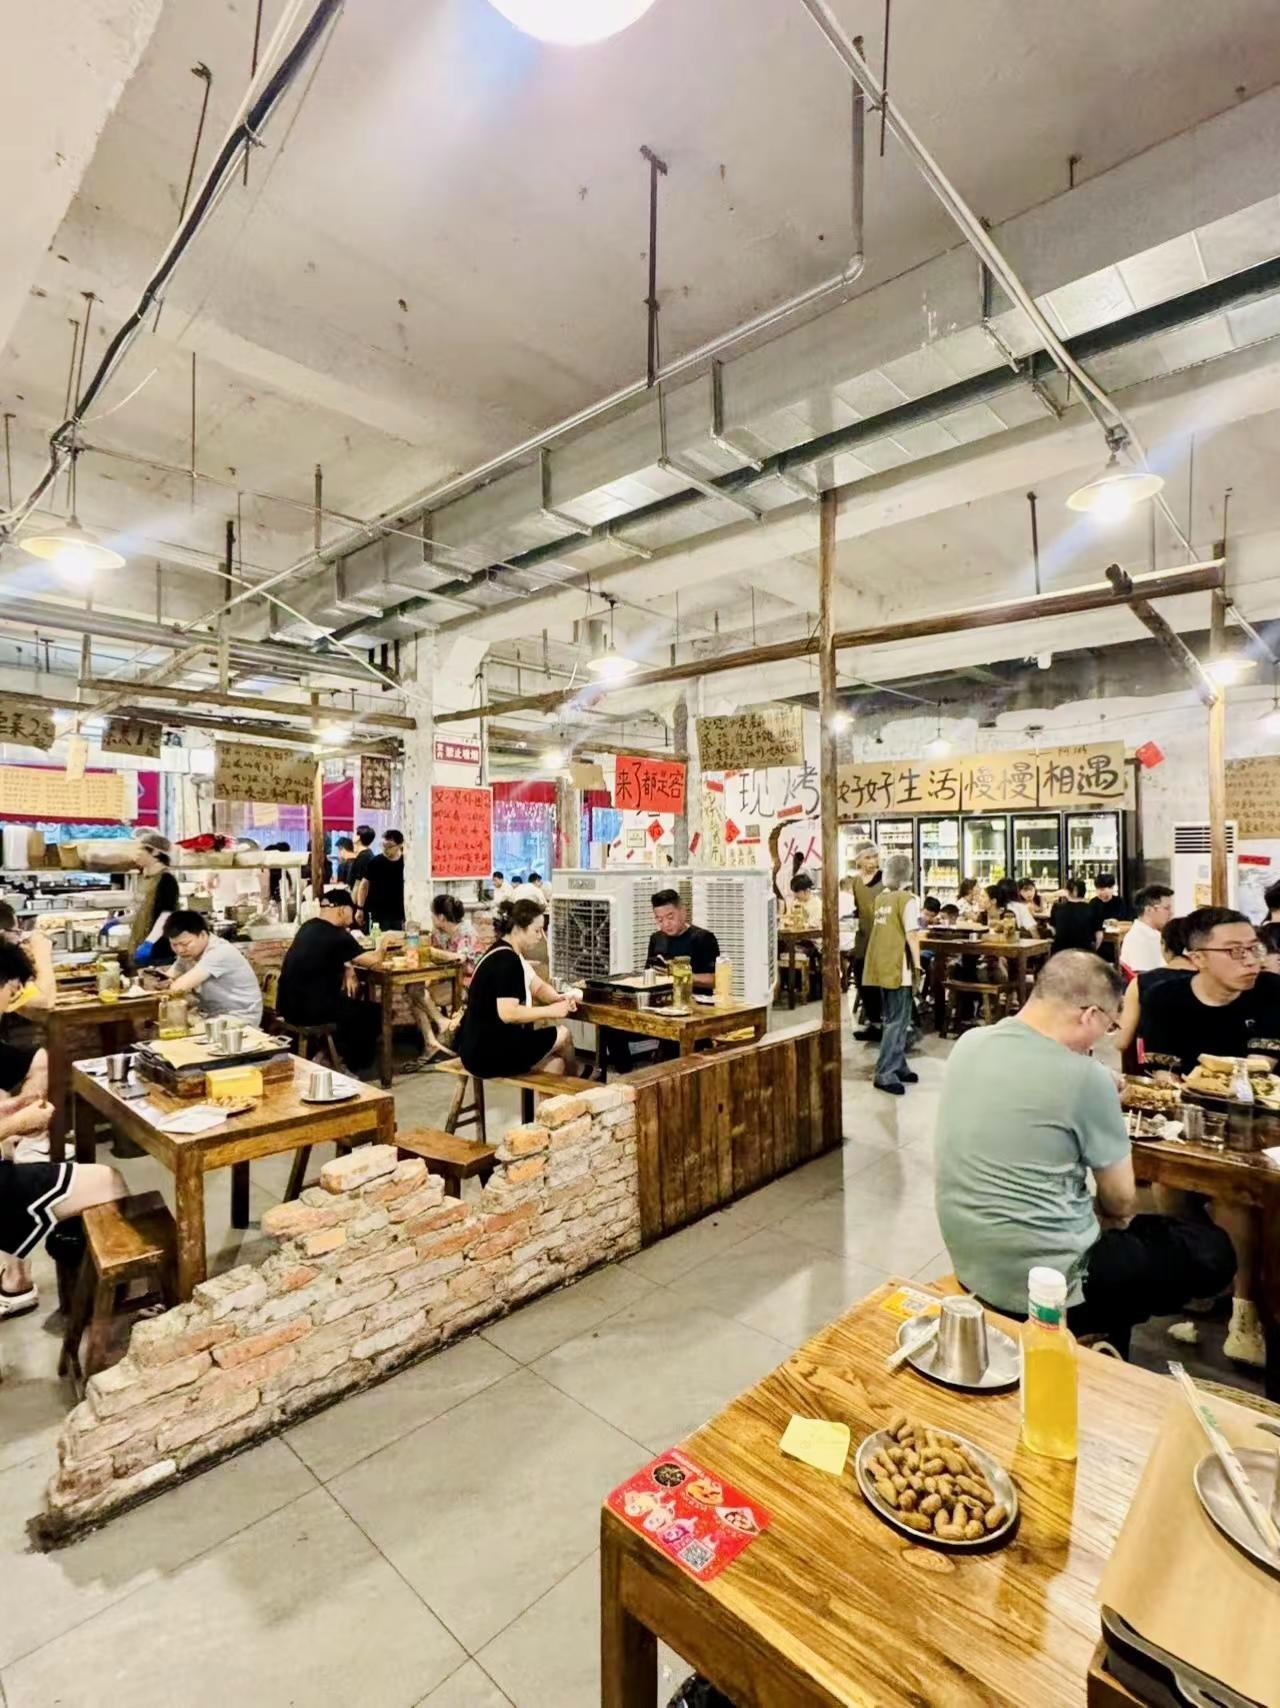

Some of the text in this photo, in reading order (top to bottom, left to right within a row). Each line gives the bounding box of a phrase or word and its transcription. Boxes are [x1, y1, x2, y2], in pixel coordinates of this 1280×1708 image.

[616, 761, 684, 809] 来了都是客
